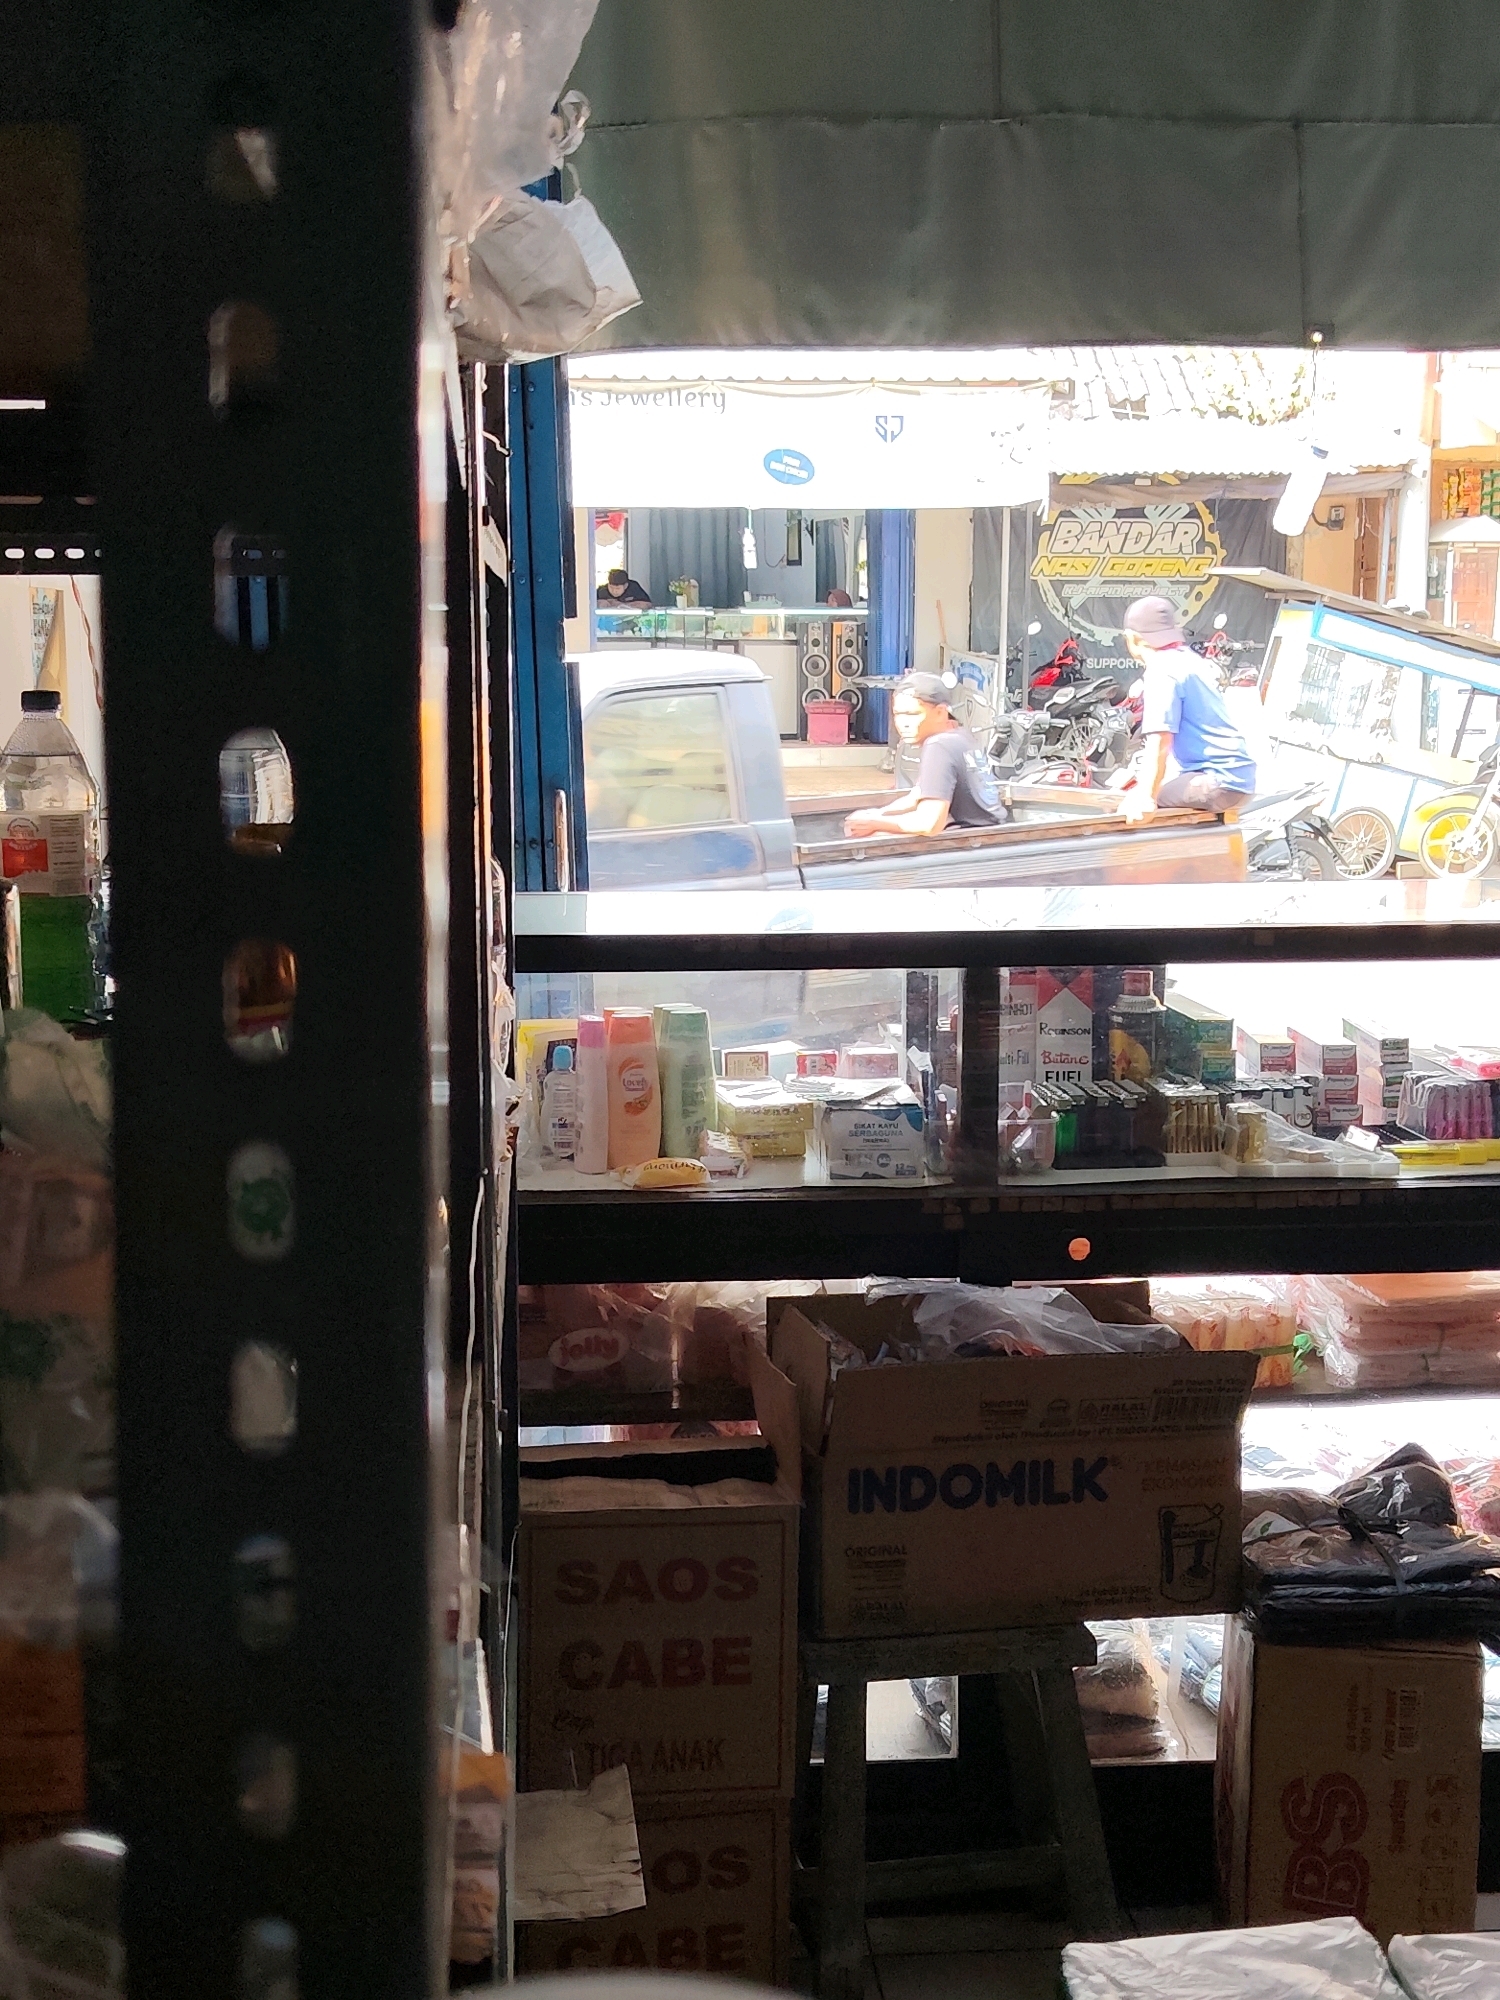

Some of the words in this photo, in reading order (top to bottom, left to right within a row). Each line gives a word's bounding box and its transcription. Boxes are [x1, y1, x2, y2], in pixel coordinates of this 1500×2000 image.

[600, 387, 726, 415] Jewellery
[874, 415, 904, 443] SJ
[1051, 520, 1200, 555] BANDAR
[1032, 556, 1101, 577] NASI
[1100, 556, 1213, 578] GORENG
[1040, 1049, 1090, 1066] Butane
[848, 1129, 904, 1137] SERBAGUNA
[854, 1122, 876, 1130] SIKAT
[847, 1456, 1109, 1514] INDOMILK
[844, 1544, 908, 1558] ORIGINAL
[553, 1555, 761, 1606] SAOS
[556, 1635, 754, 1691] CABE
[650, 1738, 727, 1773] ANAK
[1280, 1771, 1371, 1918] BS
[651, 1844, 752, 1896] OS
[556, 1922, 747, 1972] CABE
